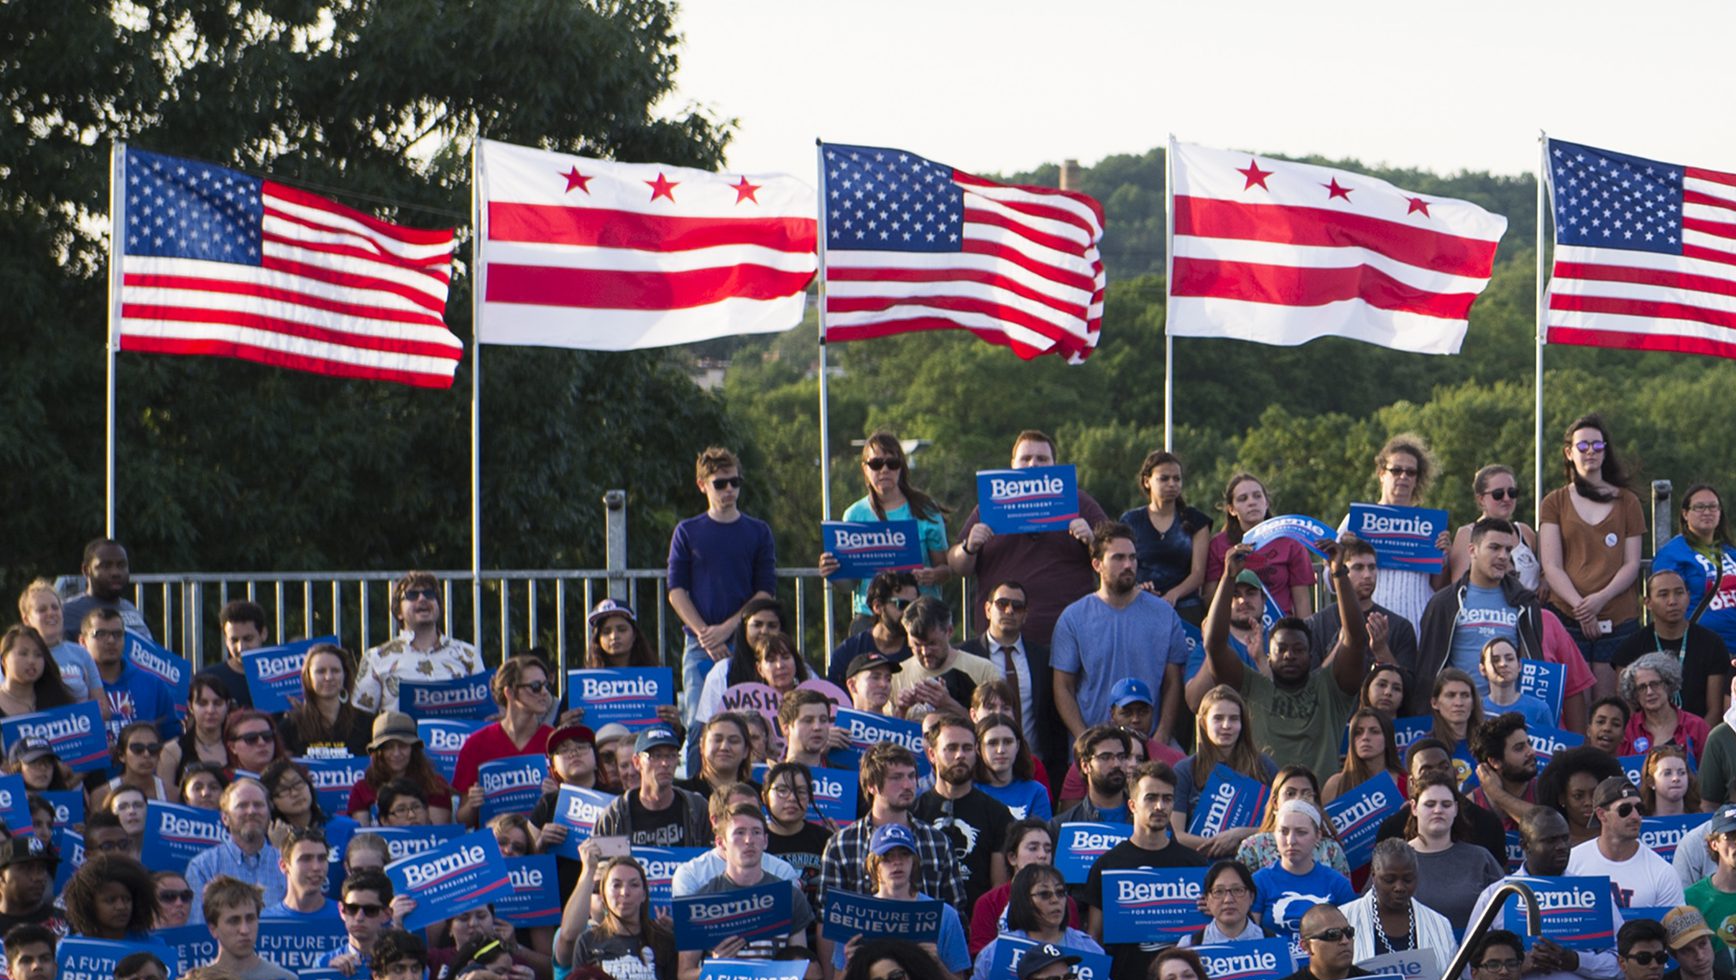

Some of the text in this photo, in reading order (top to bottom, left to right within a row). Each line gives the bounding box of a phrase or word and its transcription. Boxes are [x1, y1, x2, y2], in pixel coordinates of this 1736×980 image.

[991, 475, 1063, 498] Bernie
[1017, 501, 1052, 509] PRESIDENT
[1361, 512, 1432, 536] Bernie
[834, 530, 906, 549] Bernie
[1457, 607, 1517, 627] Bernie
[130, 641, 180, 685] Bernie
[414, 683, 488, 706] Bernie
[582, 676, 658, 697] Bernie
[851, 720, 923, 753] Bernie
[483, 766, 541, 792] Bernie
[404, 846, 485, 888] Bernie
[440, 874, 477, 891] PRESIDENT
[1118, 878, 1200, 902] Bernie
[690, 893, 774, 920] Bernie
[1516, 887, 1595, 908] ernie
[829, 914, 937, 932] BELIEVE IN
[830, 902, 938, 923] A FUTURE TO
[261, 936, 324, 949] FUTURE
[65, 957, 75, 969] A
[1199, 949, 1276, 975] Bernie
